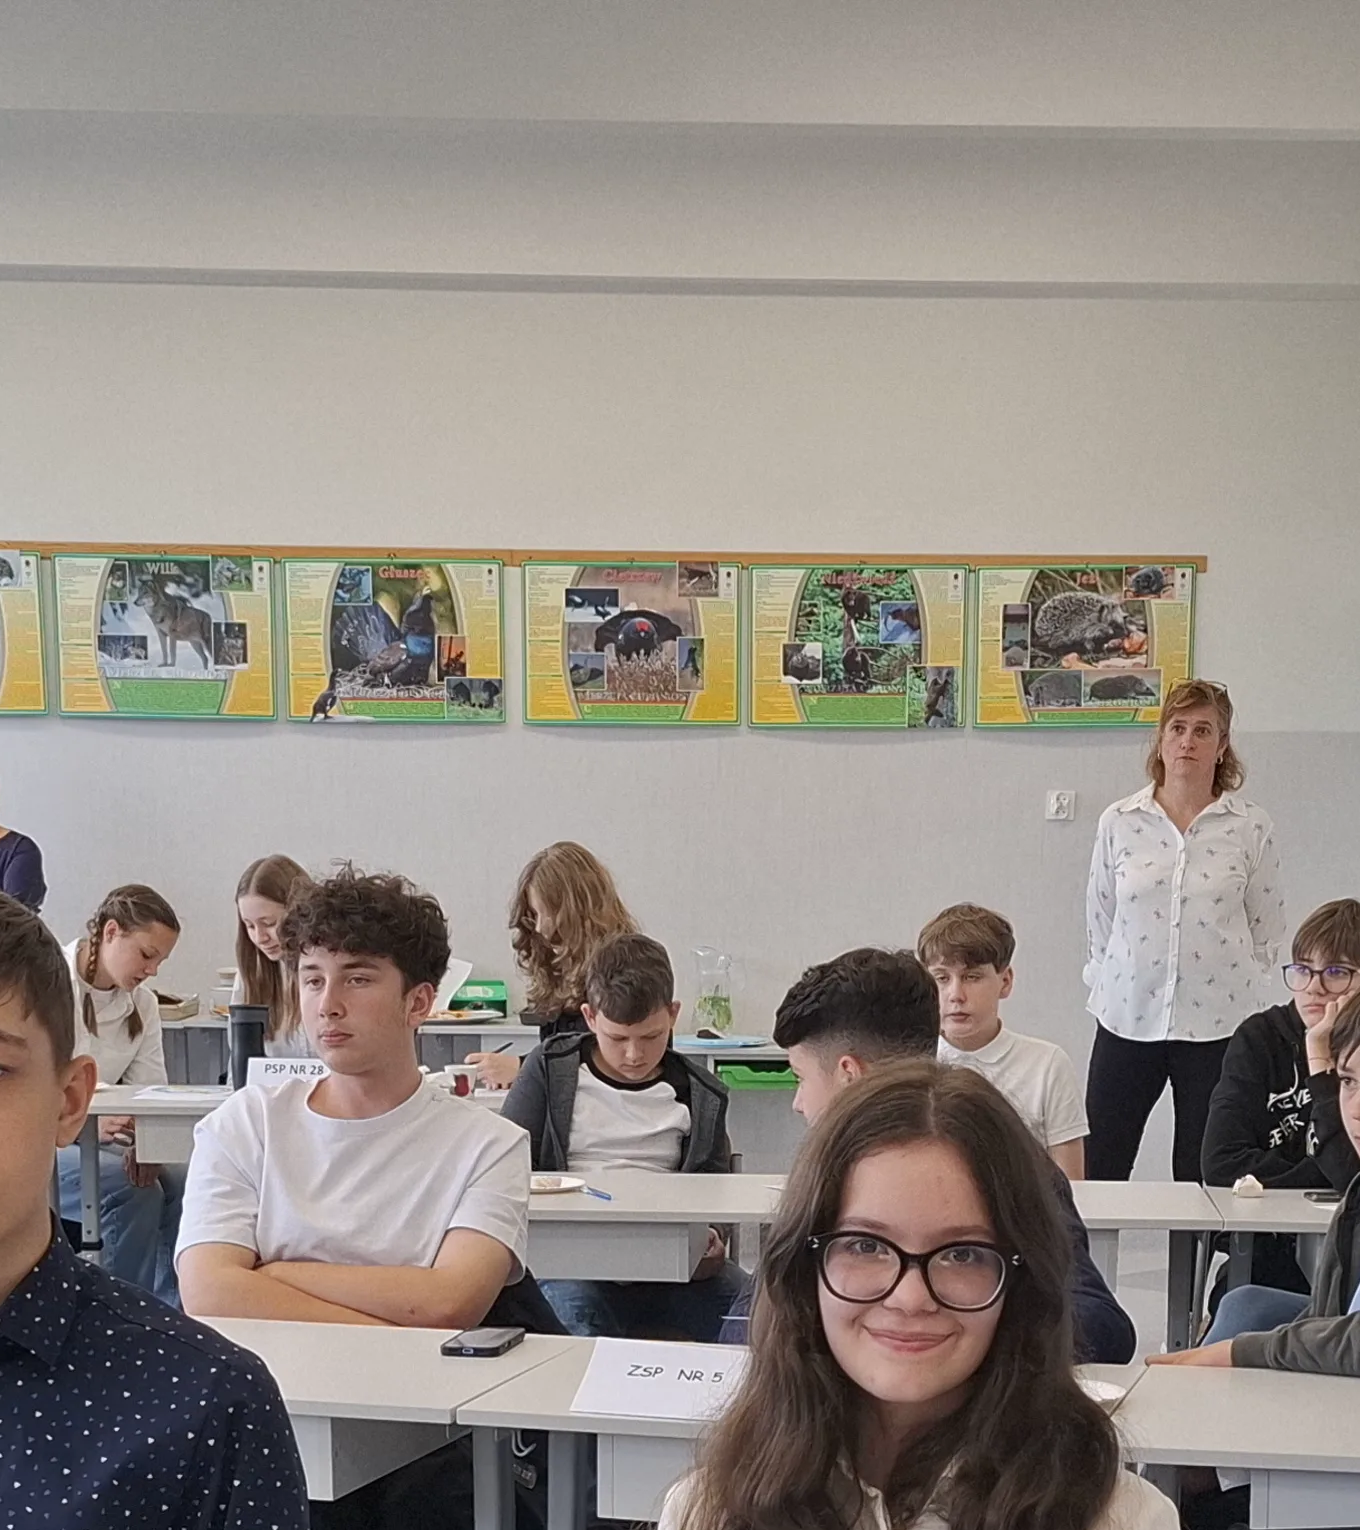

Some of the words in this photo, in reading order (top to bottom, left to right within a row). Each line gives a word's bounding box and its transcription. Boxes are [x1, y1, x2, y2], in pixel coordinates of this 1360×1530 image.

[264, 1063, 287, 1074] PSP
[289, 1064, 307, 1075] NR
[309, 1064, 325, 1076] 28
[627, 1364, 664, 1378] ZSP
[677, 1368, 705, 1382] NR
[710, 1371, 725, 1383] 5
